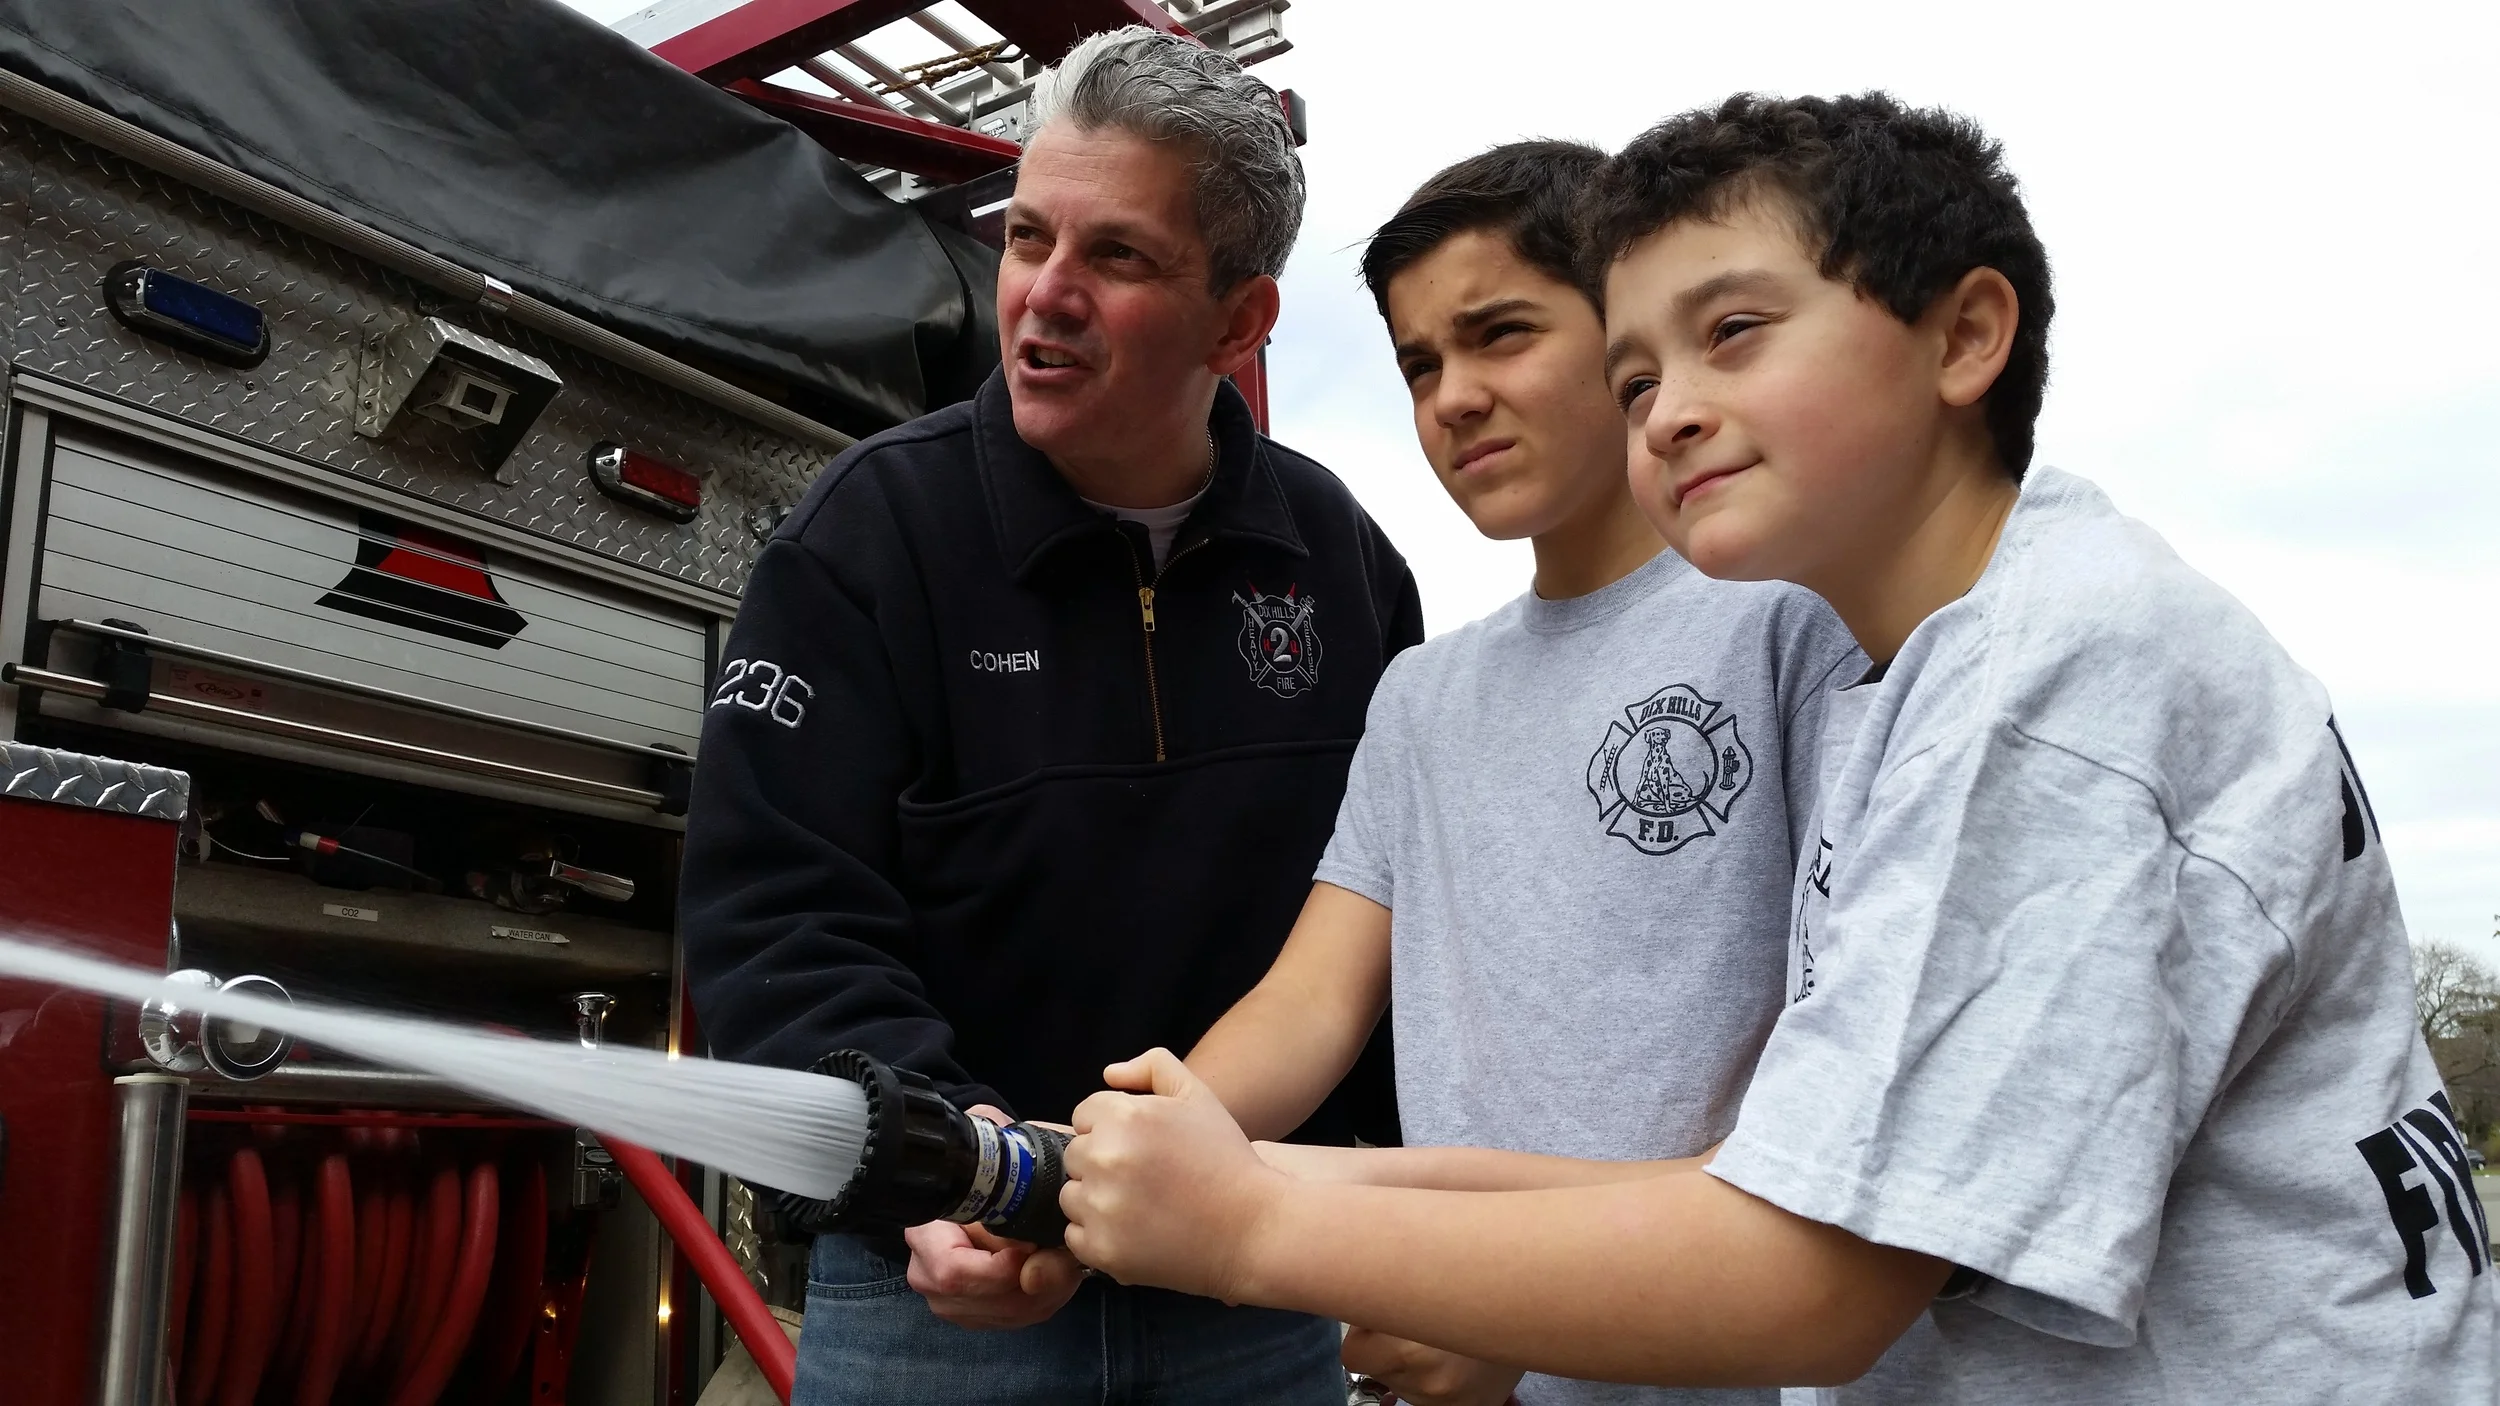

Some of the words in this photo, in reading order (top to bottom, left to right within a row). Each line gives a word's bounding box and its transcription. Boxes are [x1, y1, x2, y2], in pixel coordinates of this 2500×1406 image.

[1258, 604, 1271, 617] DIX
[1271, 606, 1296, 619] HILLS
[1248, 617, 1259, 671] HEAVY
[1270, 627, 1292, 662] 2
[1303, 620, 1315, 675] RESCUE
[970, 650, 1040, 673] COHEN
[710, 658, 816, 729] 236
[1276, 677, 1296, 690] FIRE
[1639, 698, 1667, 723] DIX
[1667, 696, 1702, 722] HILLS
[1638, 818, 1679, 843] F.D.
[341, 907, 359, 918] CO2
[508, 929, 534, 940] WATER
[534, 931, 551, 942] CAN
[1009, 1161, 1019, 1183] FOG
[1009, 1181, 1028, 1213] FLUSH
[2355, 1090, 2491, 1300] FIR
